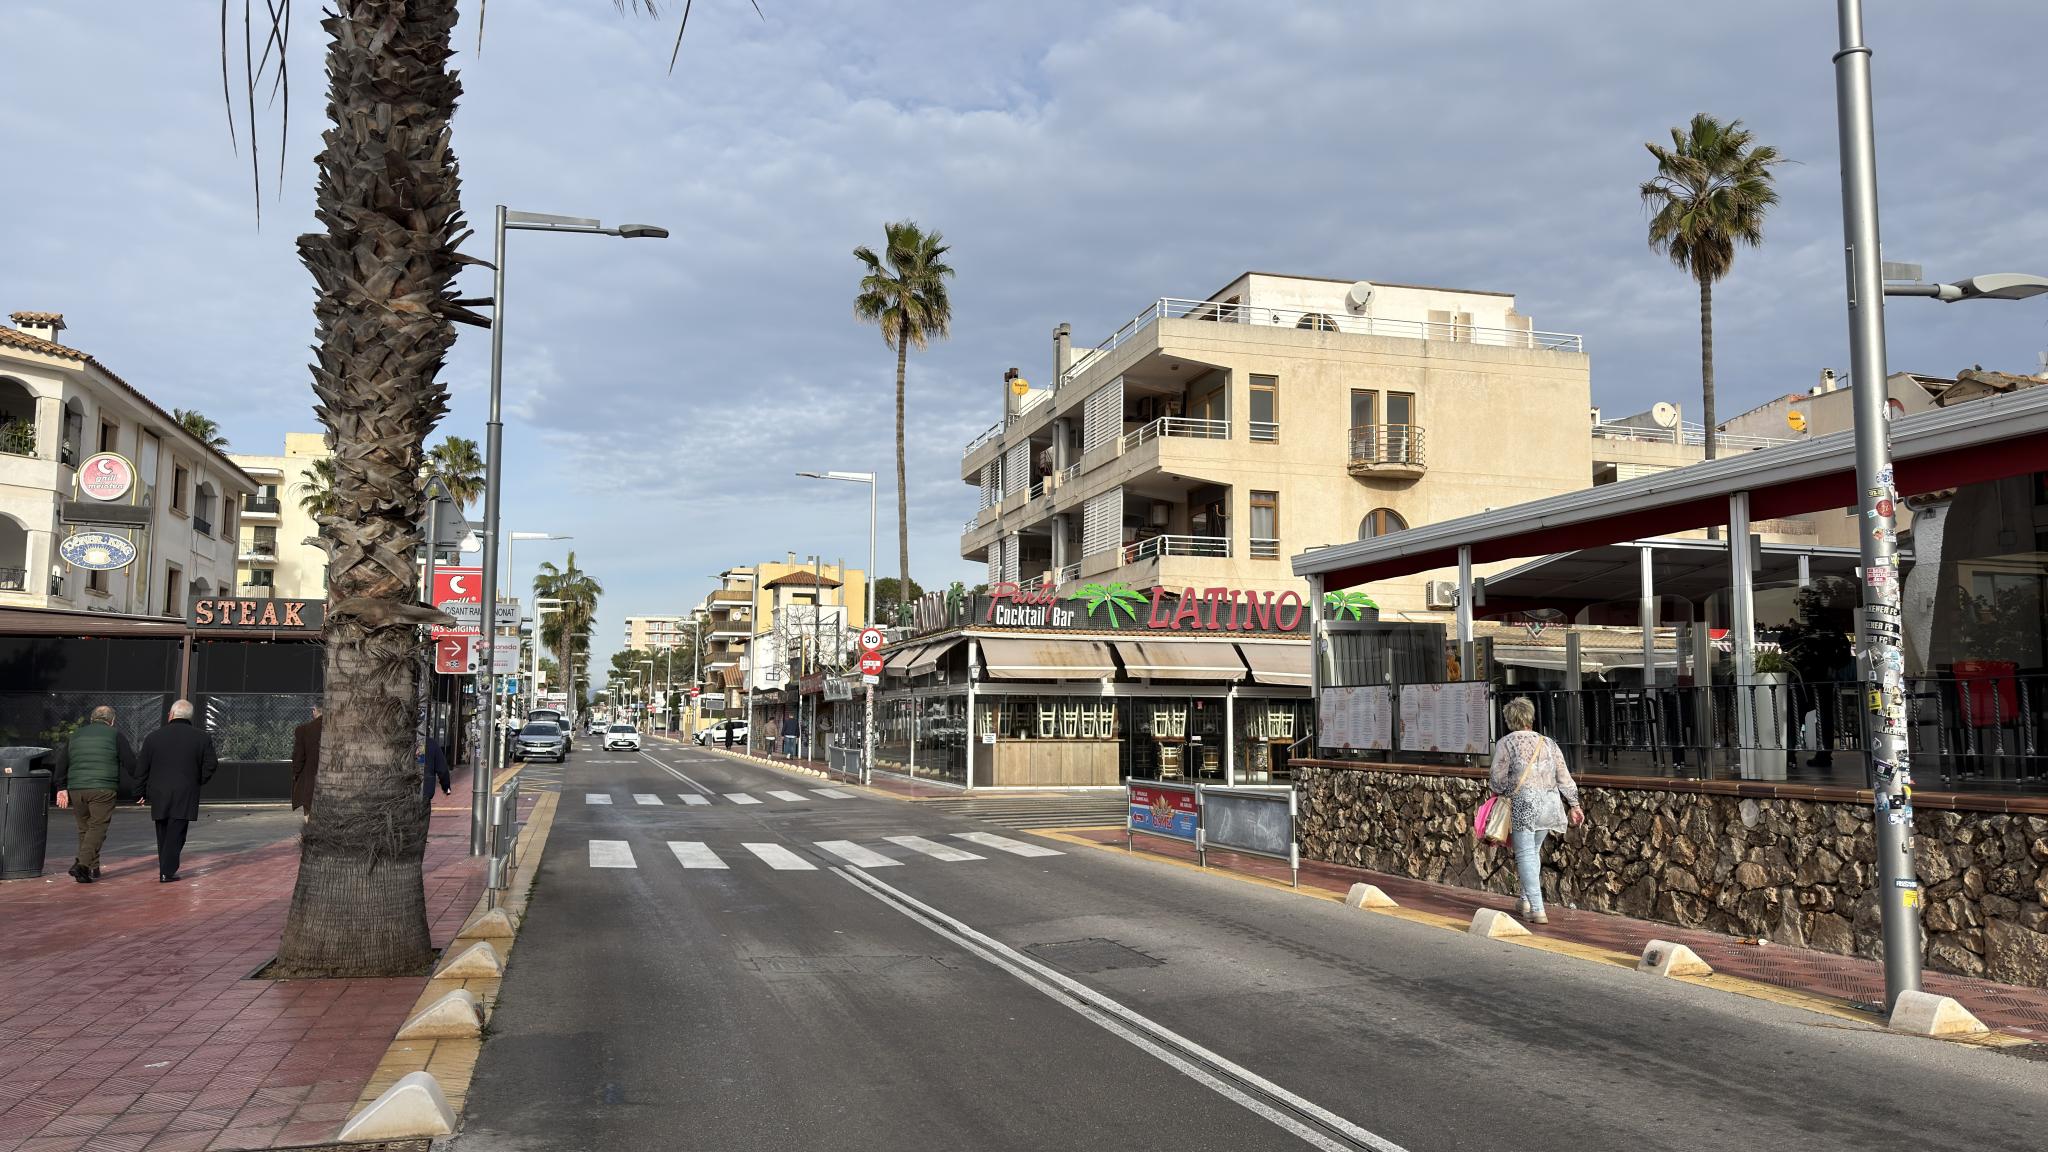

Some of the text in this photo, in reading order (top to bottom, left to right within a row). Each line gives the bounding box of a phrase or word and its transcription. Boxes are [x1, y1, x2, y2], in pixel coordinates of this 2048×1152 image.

[195, 600, 305, 626] STEAK
[986, 581, 1060, 623] Party
[1146, 586, 1303, 631] LATINO
[995, 605, 1075, 627] Cocktail Bar
[864, 635, 879, 644] 30
